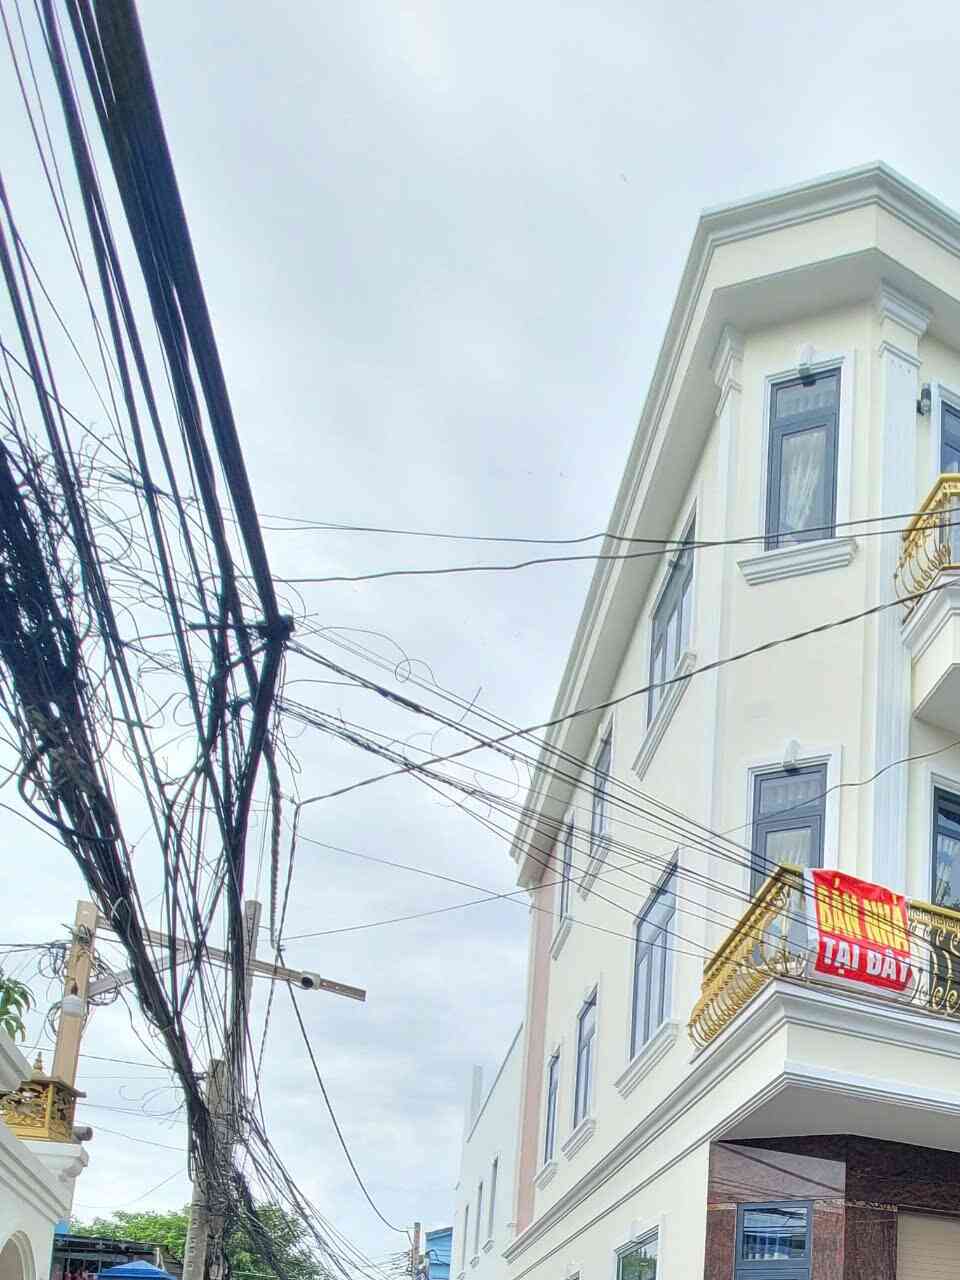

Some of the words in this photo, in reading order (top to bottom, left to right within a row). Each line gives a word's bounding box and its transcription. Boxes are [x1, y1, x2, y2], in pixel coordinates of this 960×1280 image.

[817, 877, 862, 937] BÁN
[863, 893, 910, 952] NHÀ
[821, 938, 860, 974] TẠI
